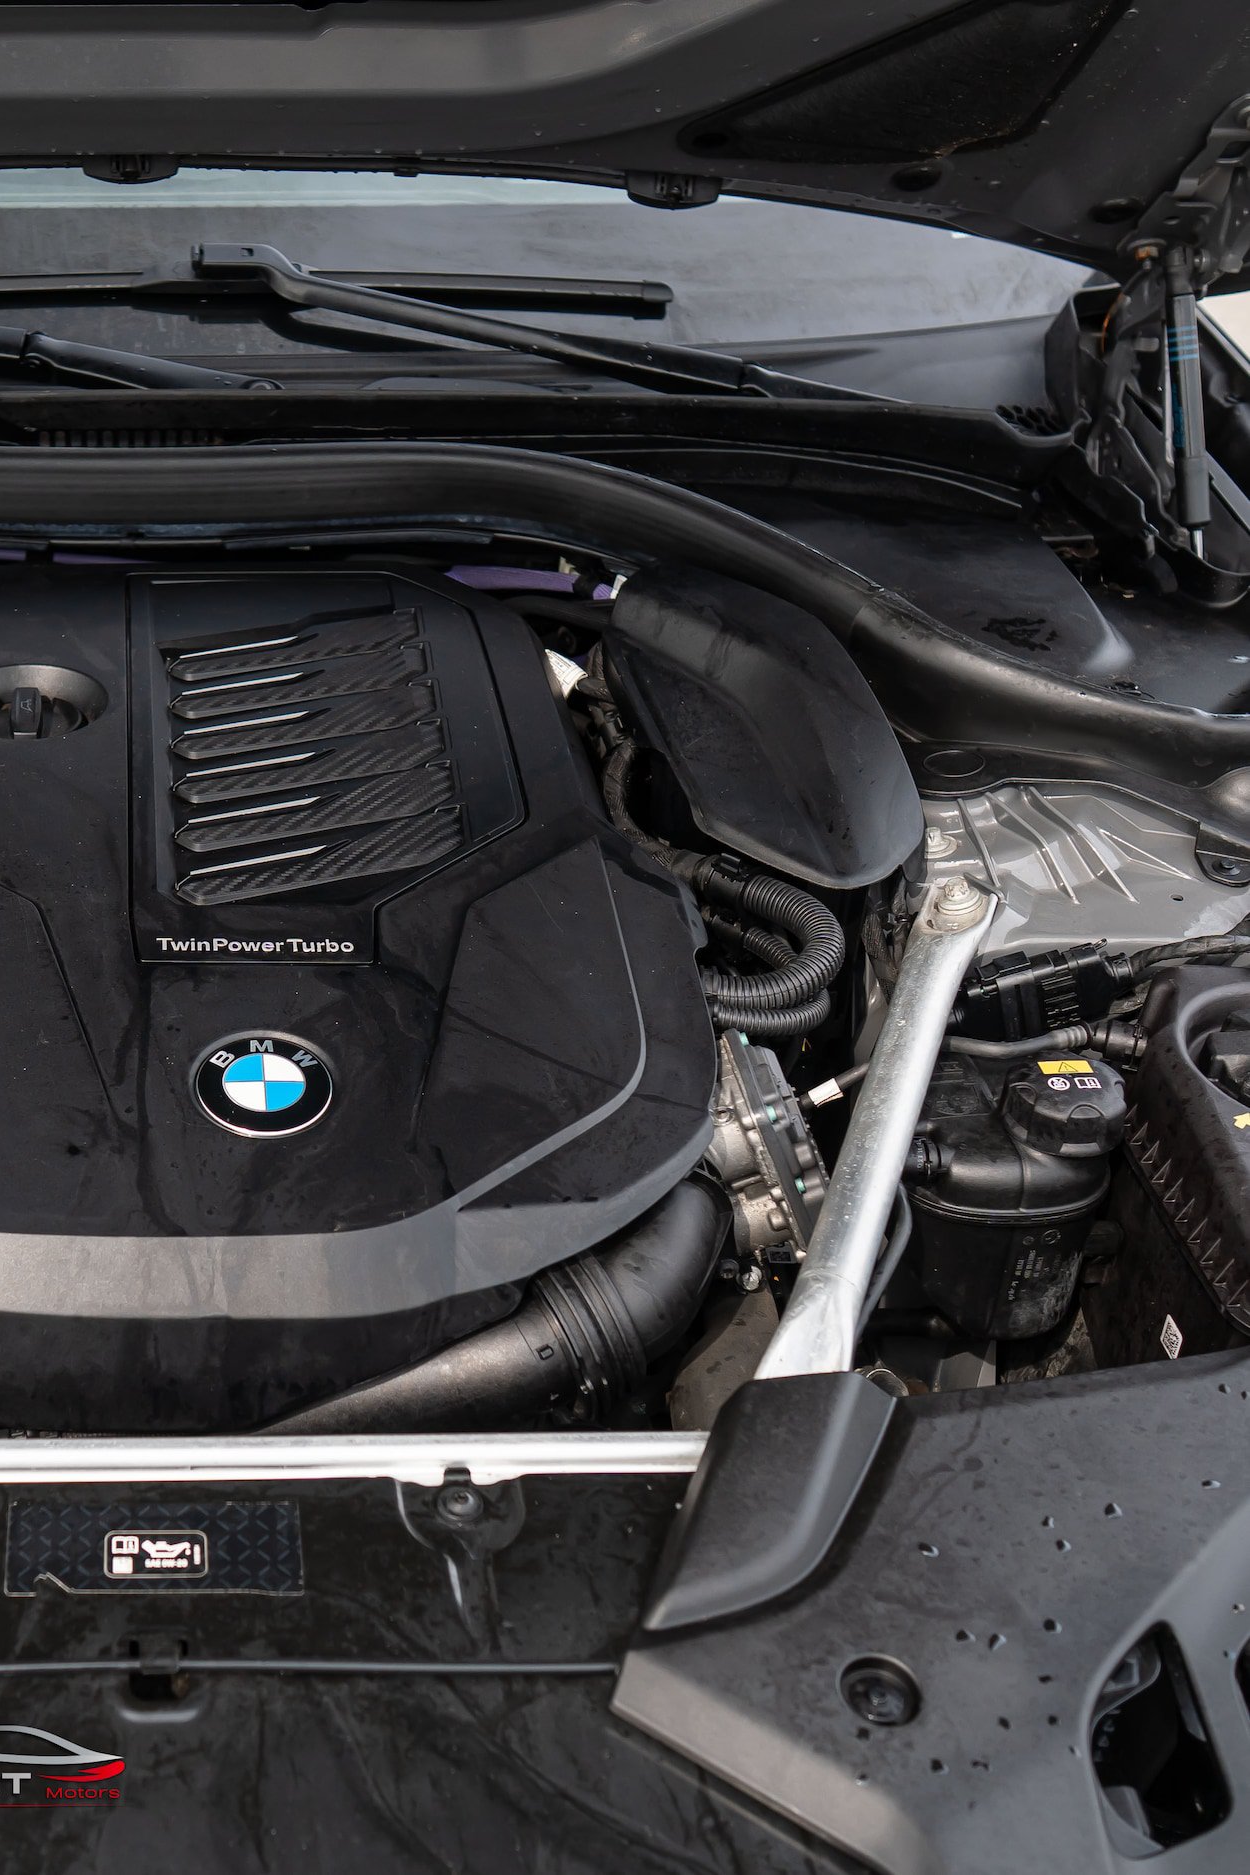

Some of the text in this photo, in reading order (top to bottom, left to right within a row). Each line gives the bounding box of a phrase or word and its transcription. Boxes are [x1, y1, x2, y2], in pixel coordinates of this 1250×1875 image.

[156, 937, 355, 953] TwinPower Turbo
[209, 1039, 319, 1069] BMW
